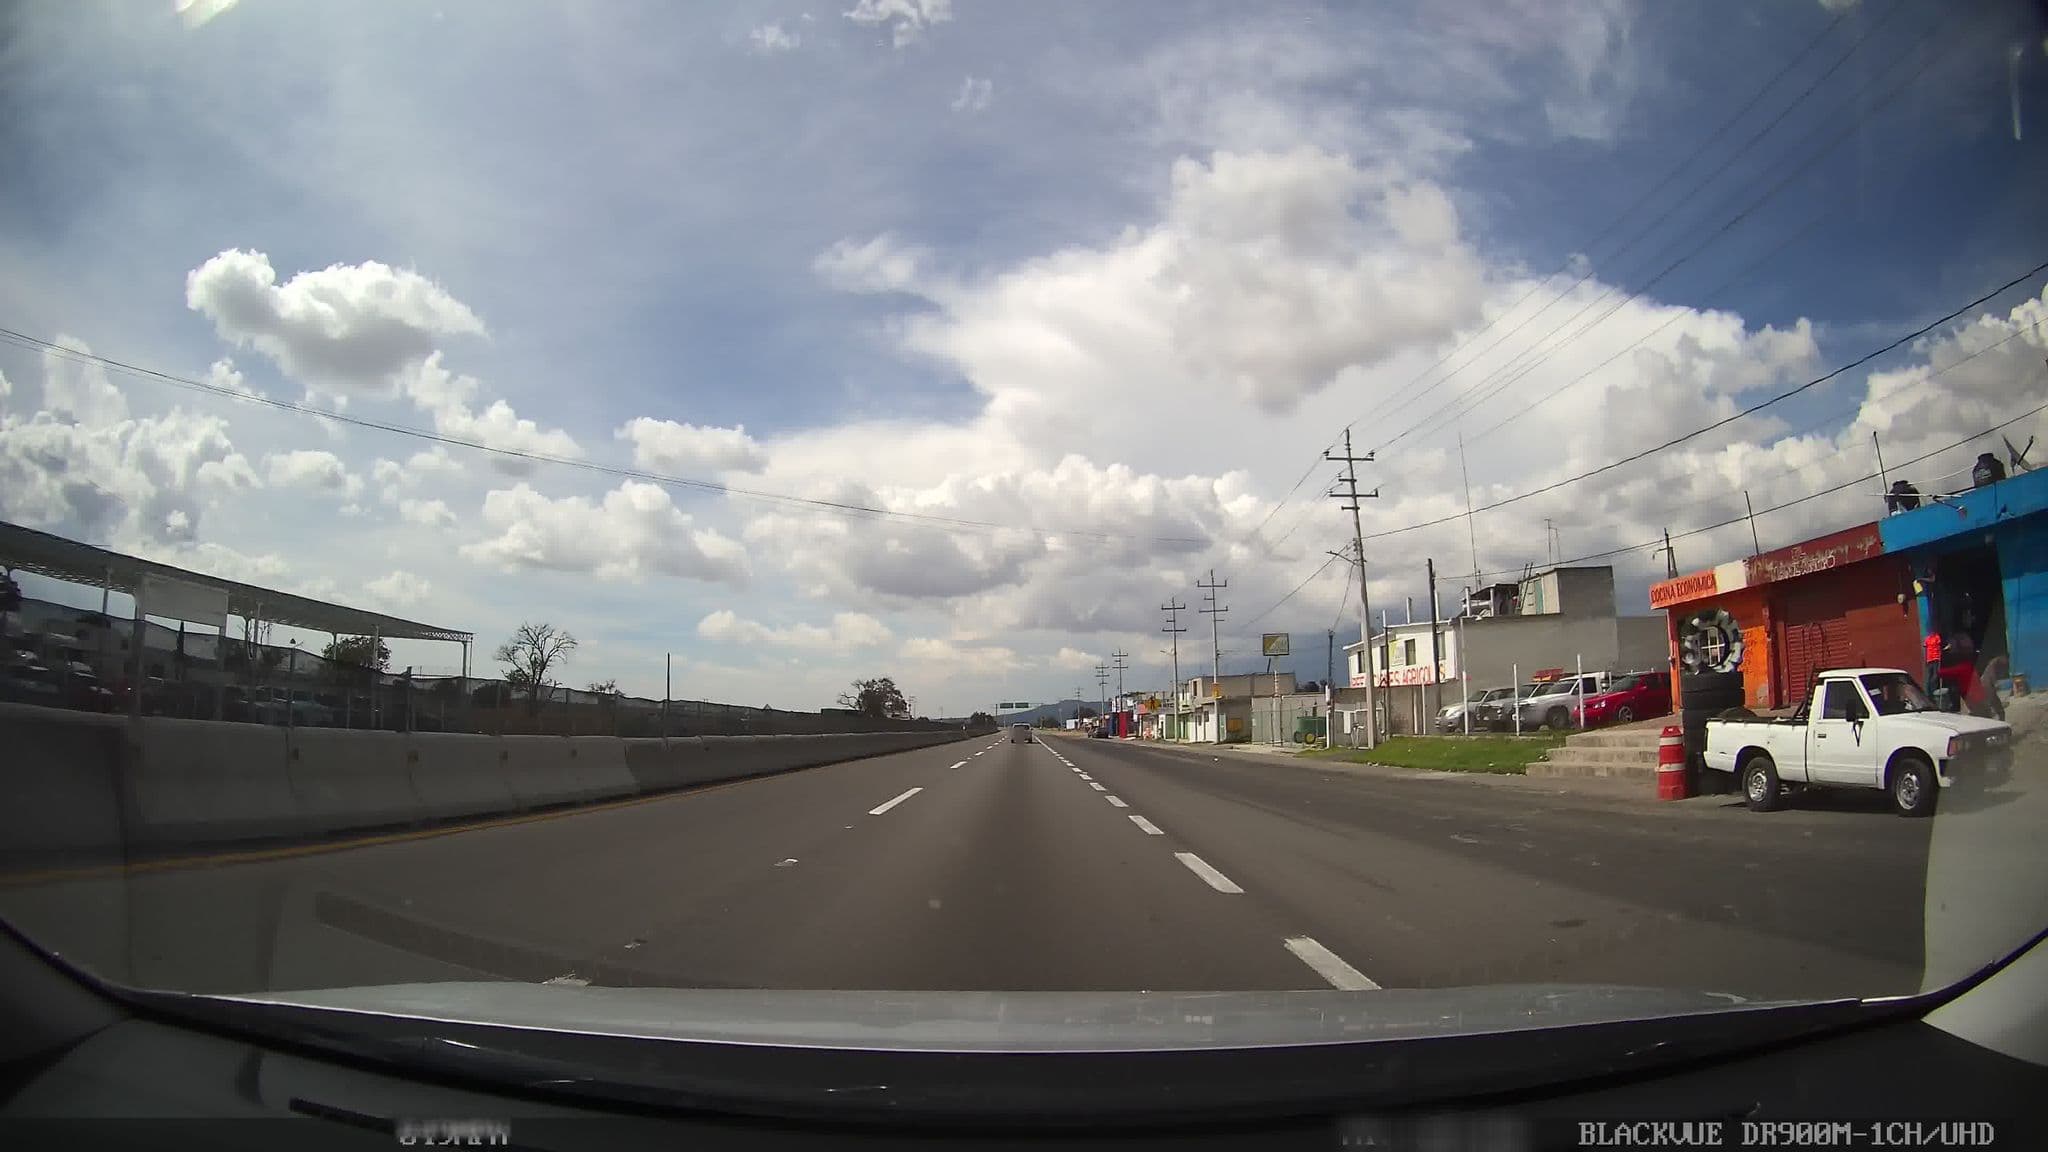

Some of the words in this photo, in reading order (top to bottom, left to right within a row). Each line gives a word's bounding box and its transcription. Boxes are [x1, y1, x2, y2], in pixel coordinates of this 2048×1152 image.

[1651, 585, 1676, 603] COCINA
[1676, 575, 1715, 597] ECONOMICA
[1402, 663, 1446, 684] AGRICOLS
